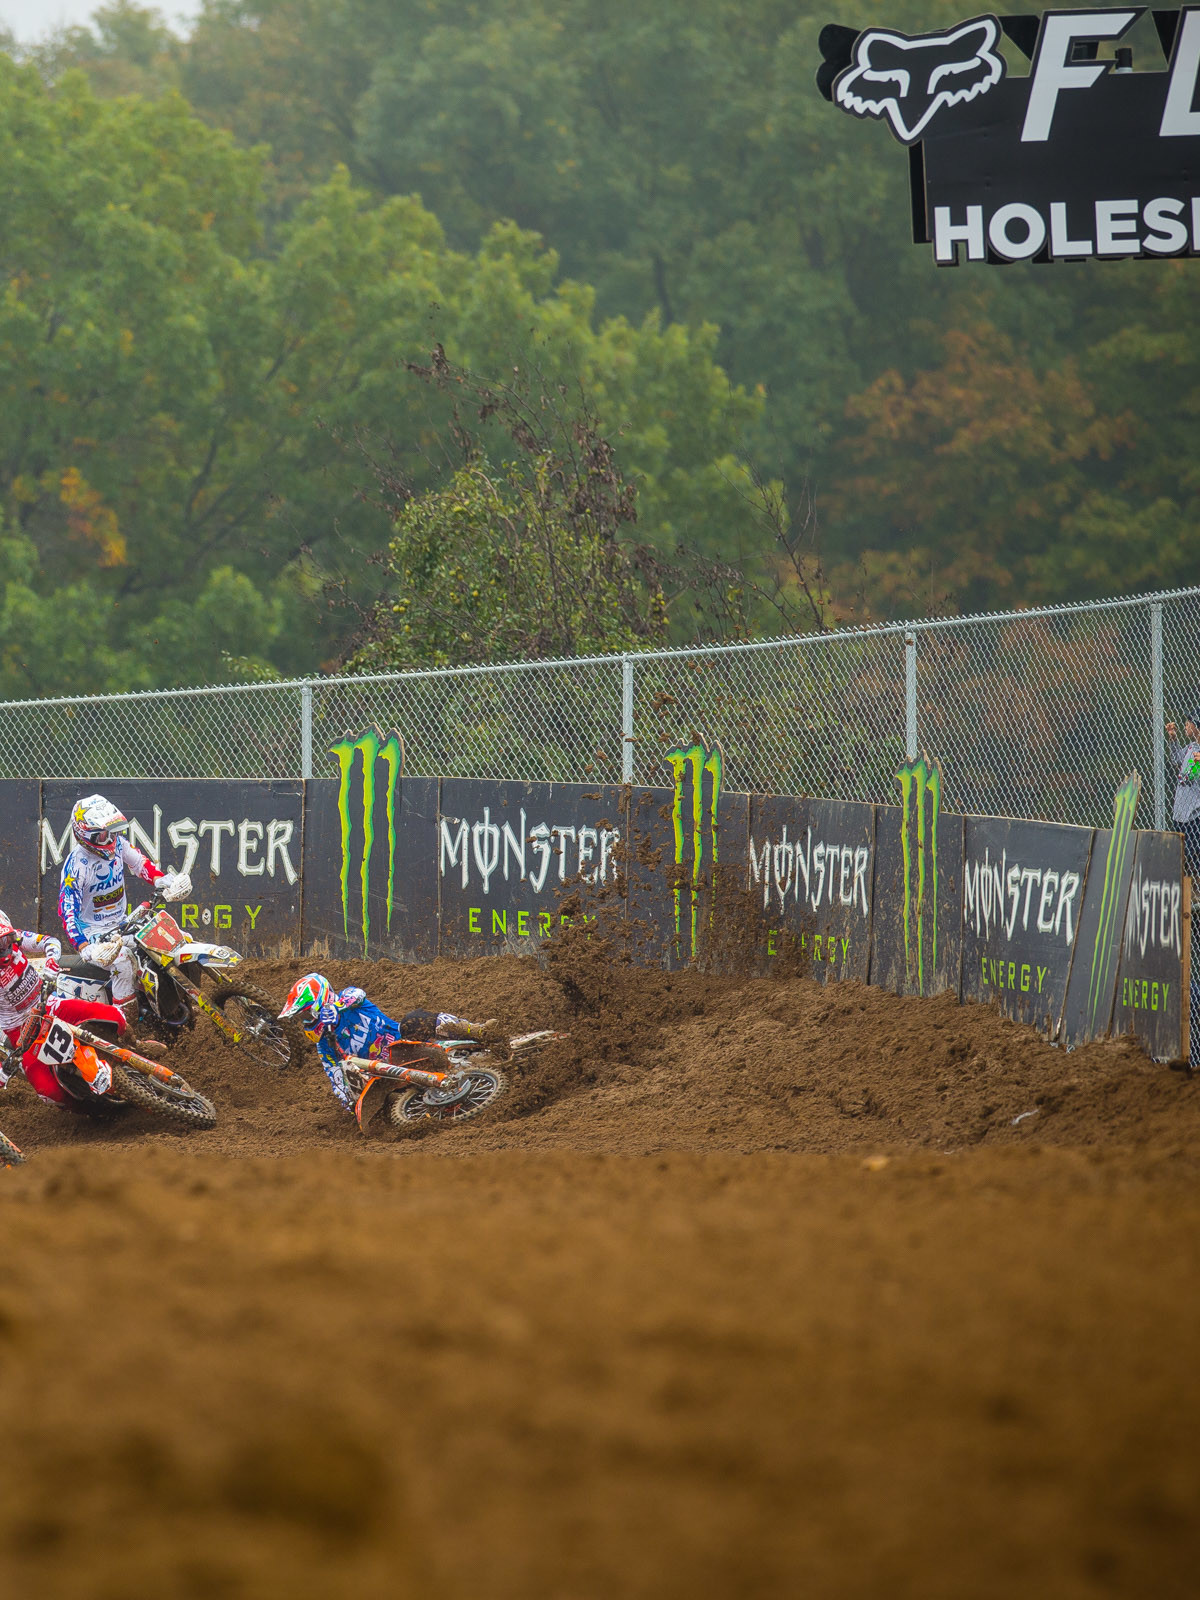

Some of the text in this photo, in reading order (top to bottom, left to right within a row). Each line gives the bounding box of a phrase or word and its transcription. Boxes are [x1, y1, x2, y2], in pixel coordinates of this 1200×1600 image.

[933, 196, 1200, 261] HOLES
[40, 803, 299, 886] MNSTER
[89, 870, 123, 893] FRANC
[963, 846, 1081, 947] MONSTER
[157, 925, 176, 946] 1
[467, 906, 597, 940] ENER
[767, 928, 850, 964] ERGY
[981, 956, 1048, 994] ENERGY
[1123, 977, 1171, 1013] ENERGY
[43, 1023, 72, 1063] 13
